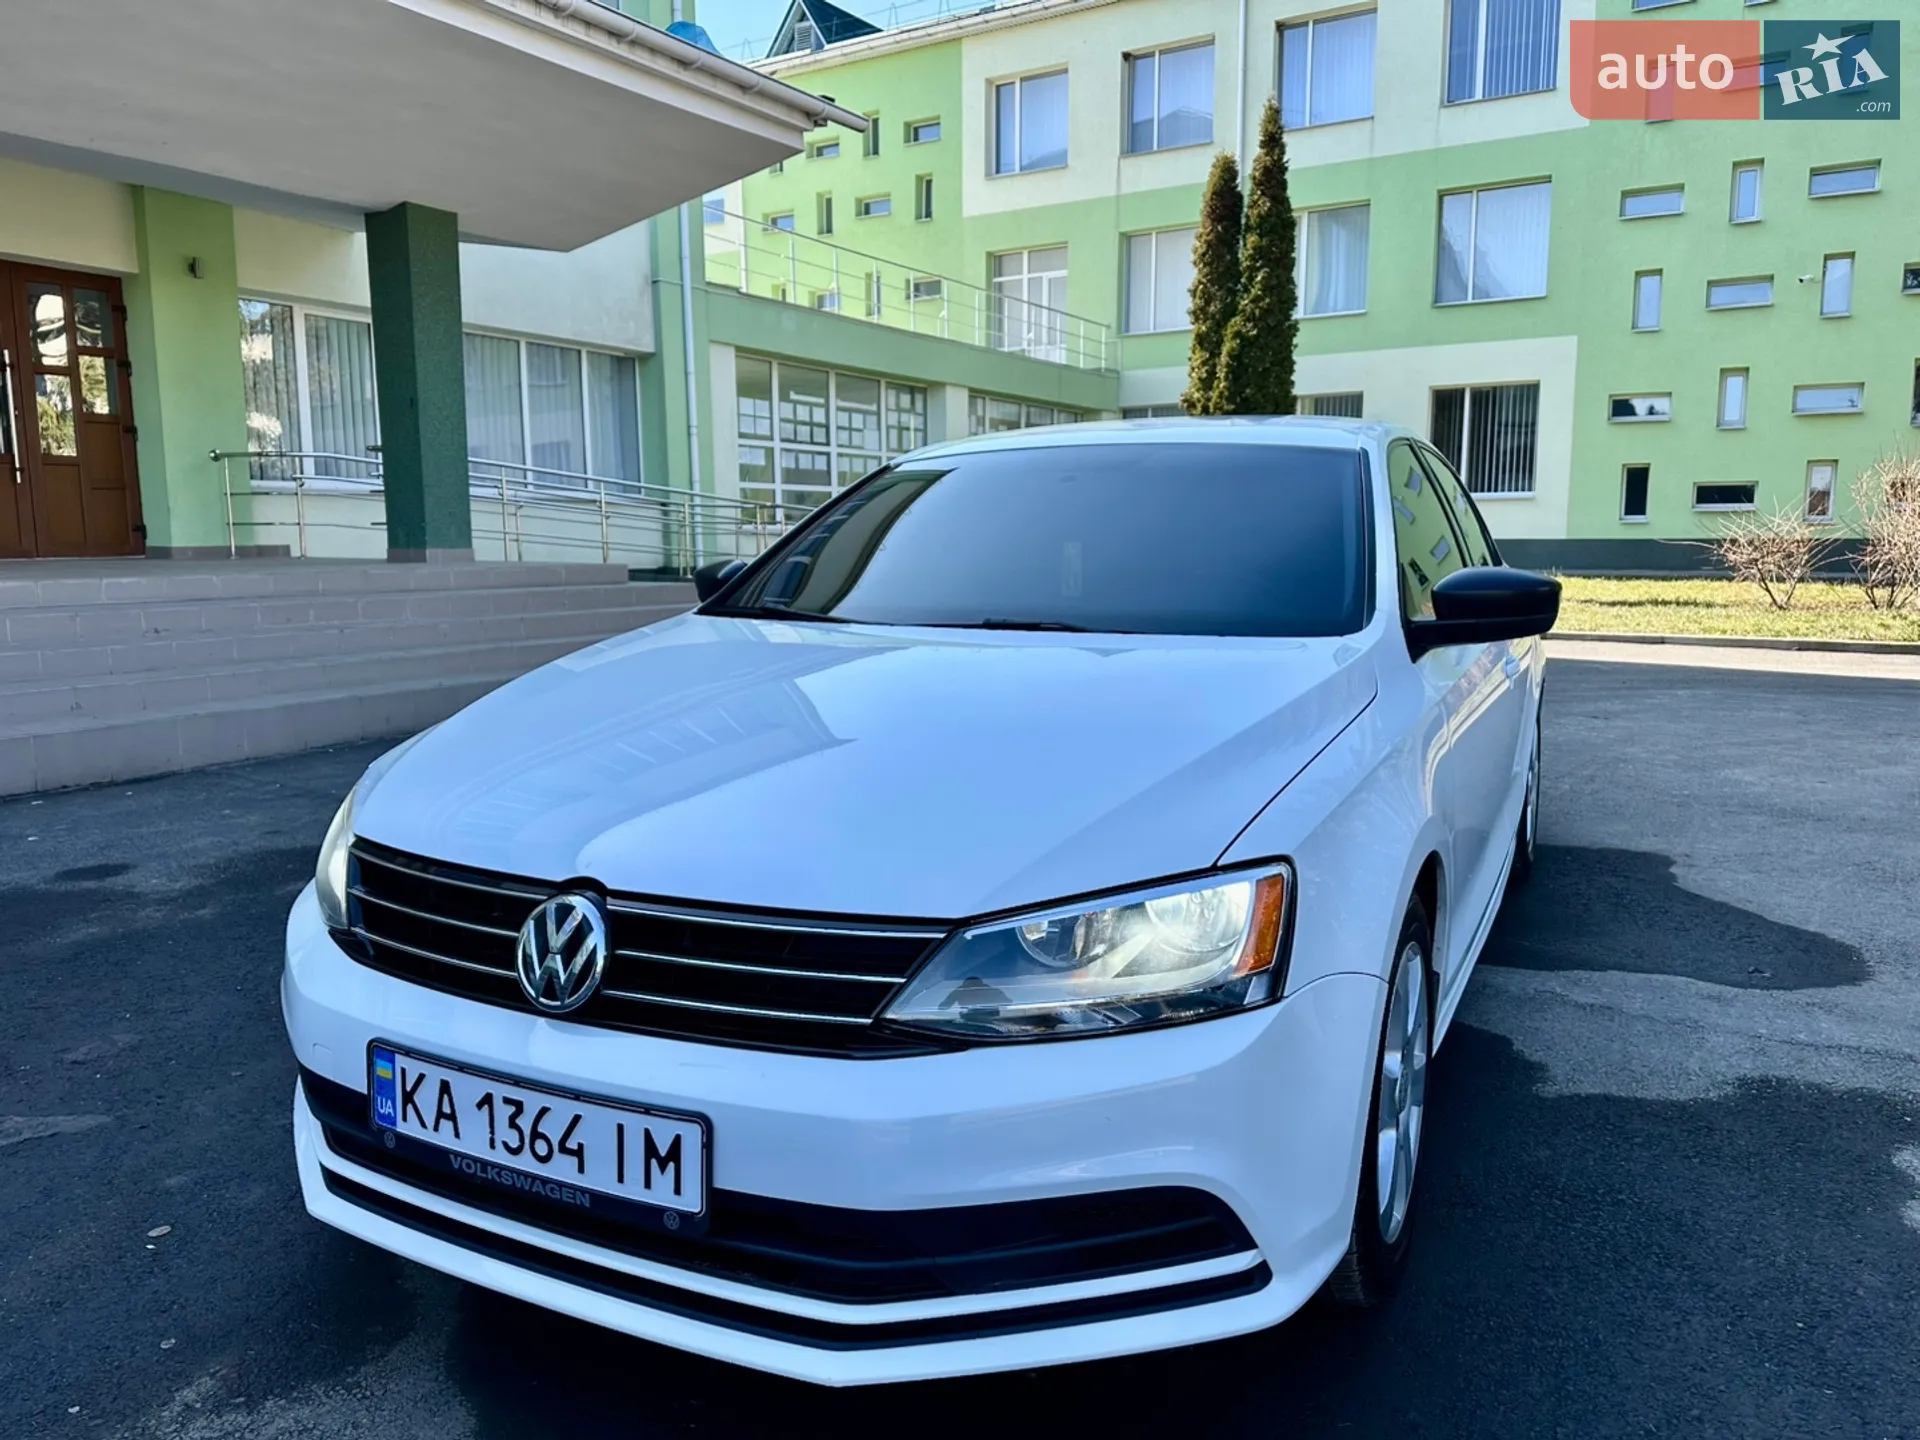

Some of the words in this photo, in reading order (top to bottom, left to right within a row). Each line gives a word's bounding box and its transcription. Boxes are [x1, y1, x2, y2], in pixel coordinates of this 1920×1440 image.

[377, 1095, 395, 1117] UA
[400, 1066, 461, 1140] KA
[475, 1091, 585, 1175] 1364
[616, 1122, 683, 1196] IM
[449, 1154, 591, 1207] VOLKSWAGEN
